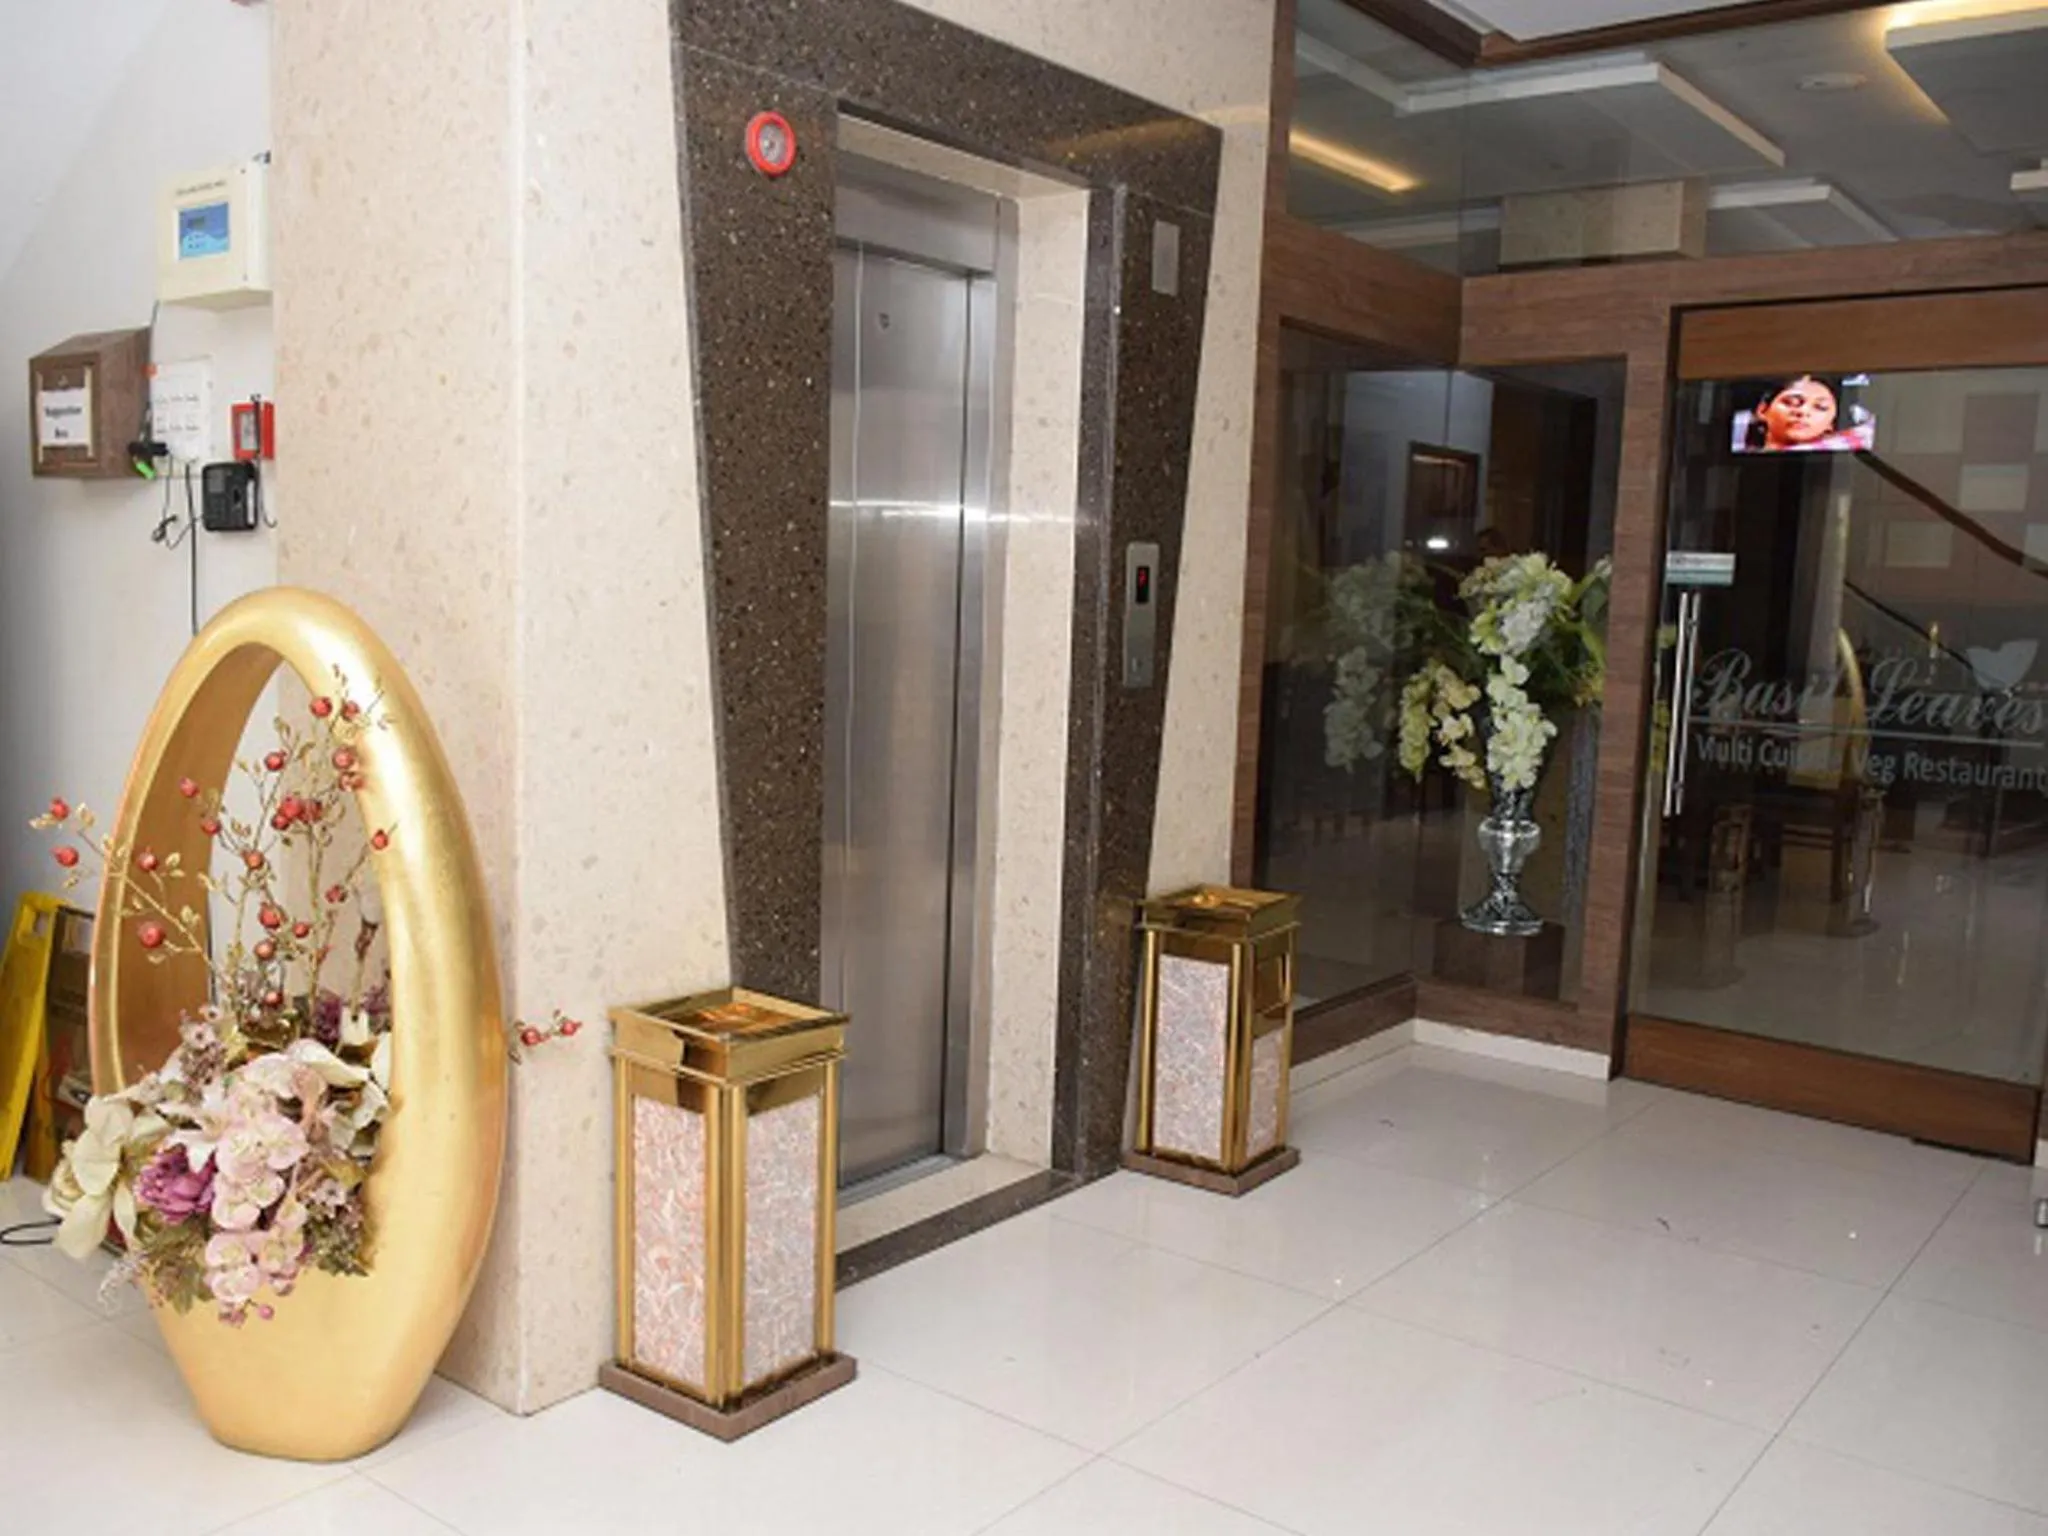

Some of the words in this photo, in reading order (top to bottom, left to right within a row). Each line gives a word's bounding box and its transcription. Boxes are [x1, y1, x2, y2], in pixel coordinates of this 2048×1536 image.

[1692, 648, 1844, 716] Basil
[1866, 657, 2044, 736] Leaves
[1851, 746, 1896, 785] Veg
[1902, 749, 2048, 793] Restaurant
